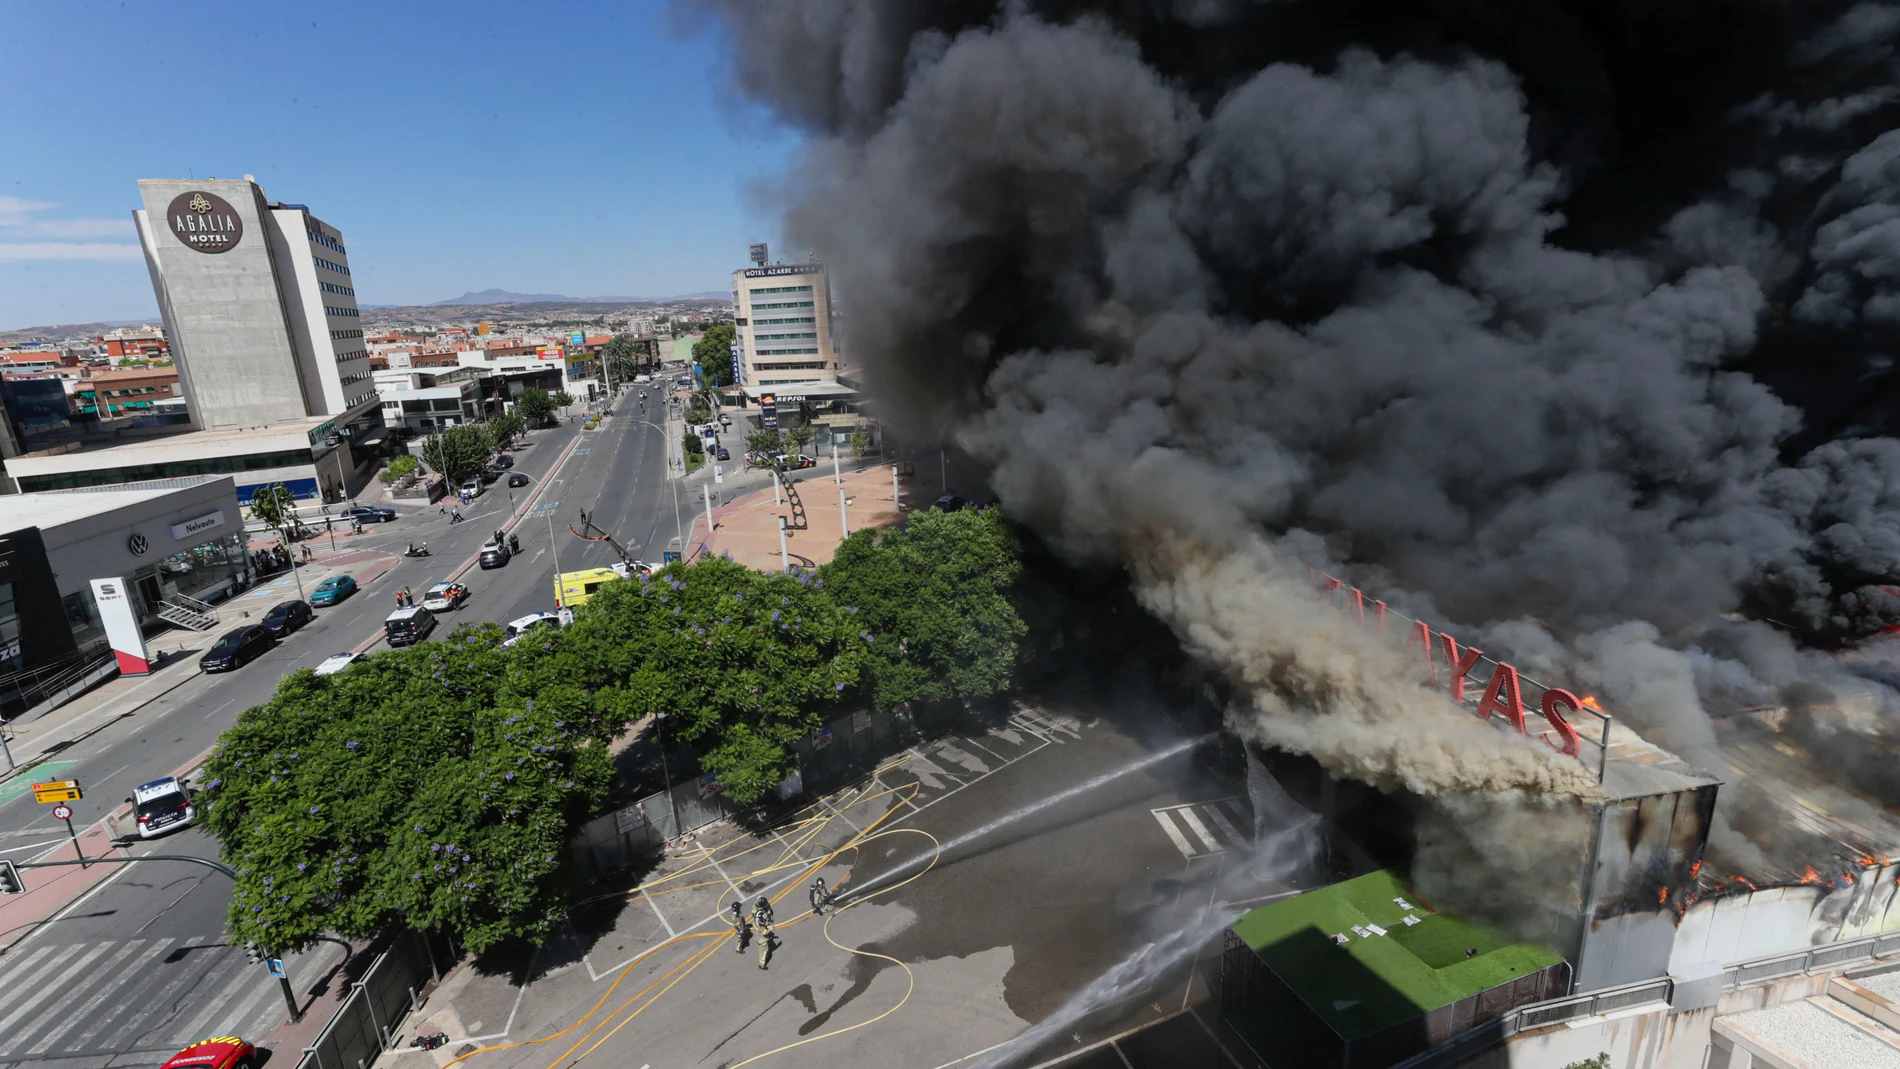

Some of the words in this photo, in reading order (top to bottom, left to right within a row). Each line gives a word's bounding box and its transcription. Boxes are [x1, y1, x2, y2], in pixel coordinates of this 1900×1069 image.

[176, 214, 236, 232] AGALIA
[189, 234, 229, 243] HOTEL
[746, 269, 765, 277] HOTEL
[767, 267, 792, 275] AZARBE
[186, 519, 216, 533] Nelvauto
